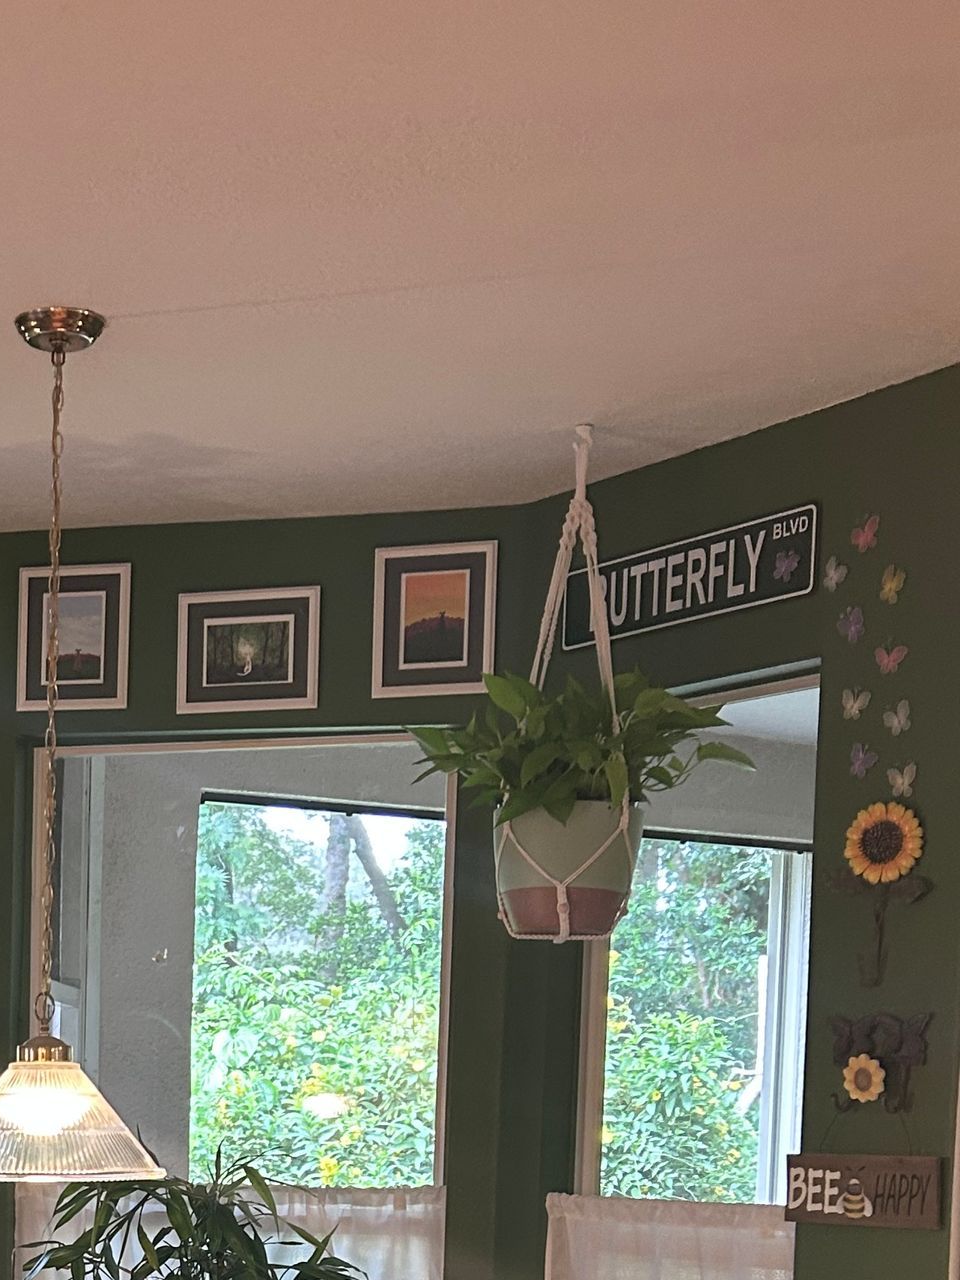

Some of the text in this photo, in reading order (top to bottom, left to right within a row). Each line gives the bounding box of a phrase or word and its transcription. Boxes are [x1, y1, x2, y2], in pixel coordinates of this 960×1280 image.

[589, 516, 809, 632] UTTERFLY BLVD
[788, 1167, 932, 1217] BEE HAPPY
